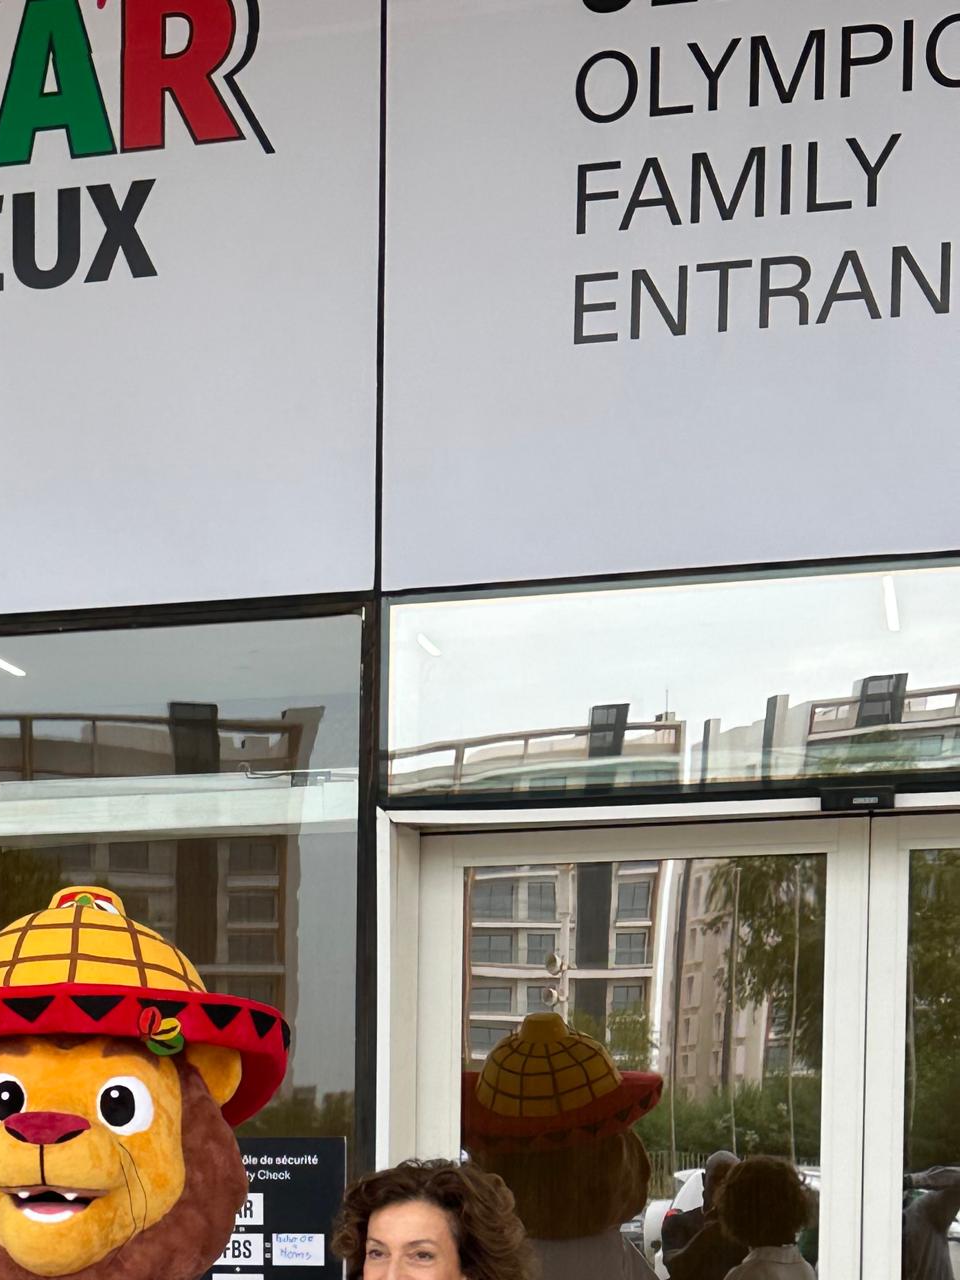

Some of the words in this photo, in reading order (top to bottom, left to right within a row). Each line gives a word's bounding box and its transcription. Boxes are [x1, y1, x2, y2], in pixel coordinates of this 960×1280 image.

[576, 133, 902, 235] FAMILY
[260, 1154, 273, 1165] de
[257, 1169, 291, 1180] Check
